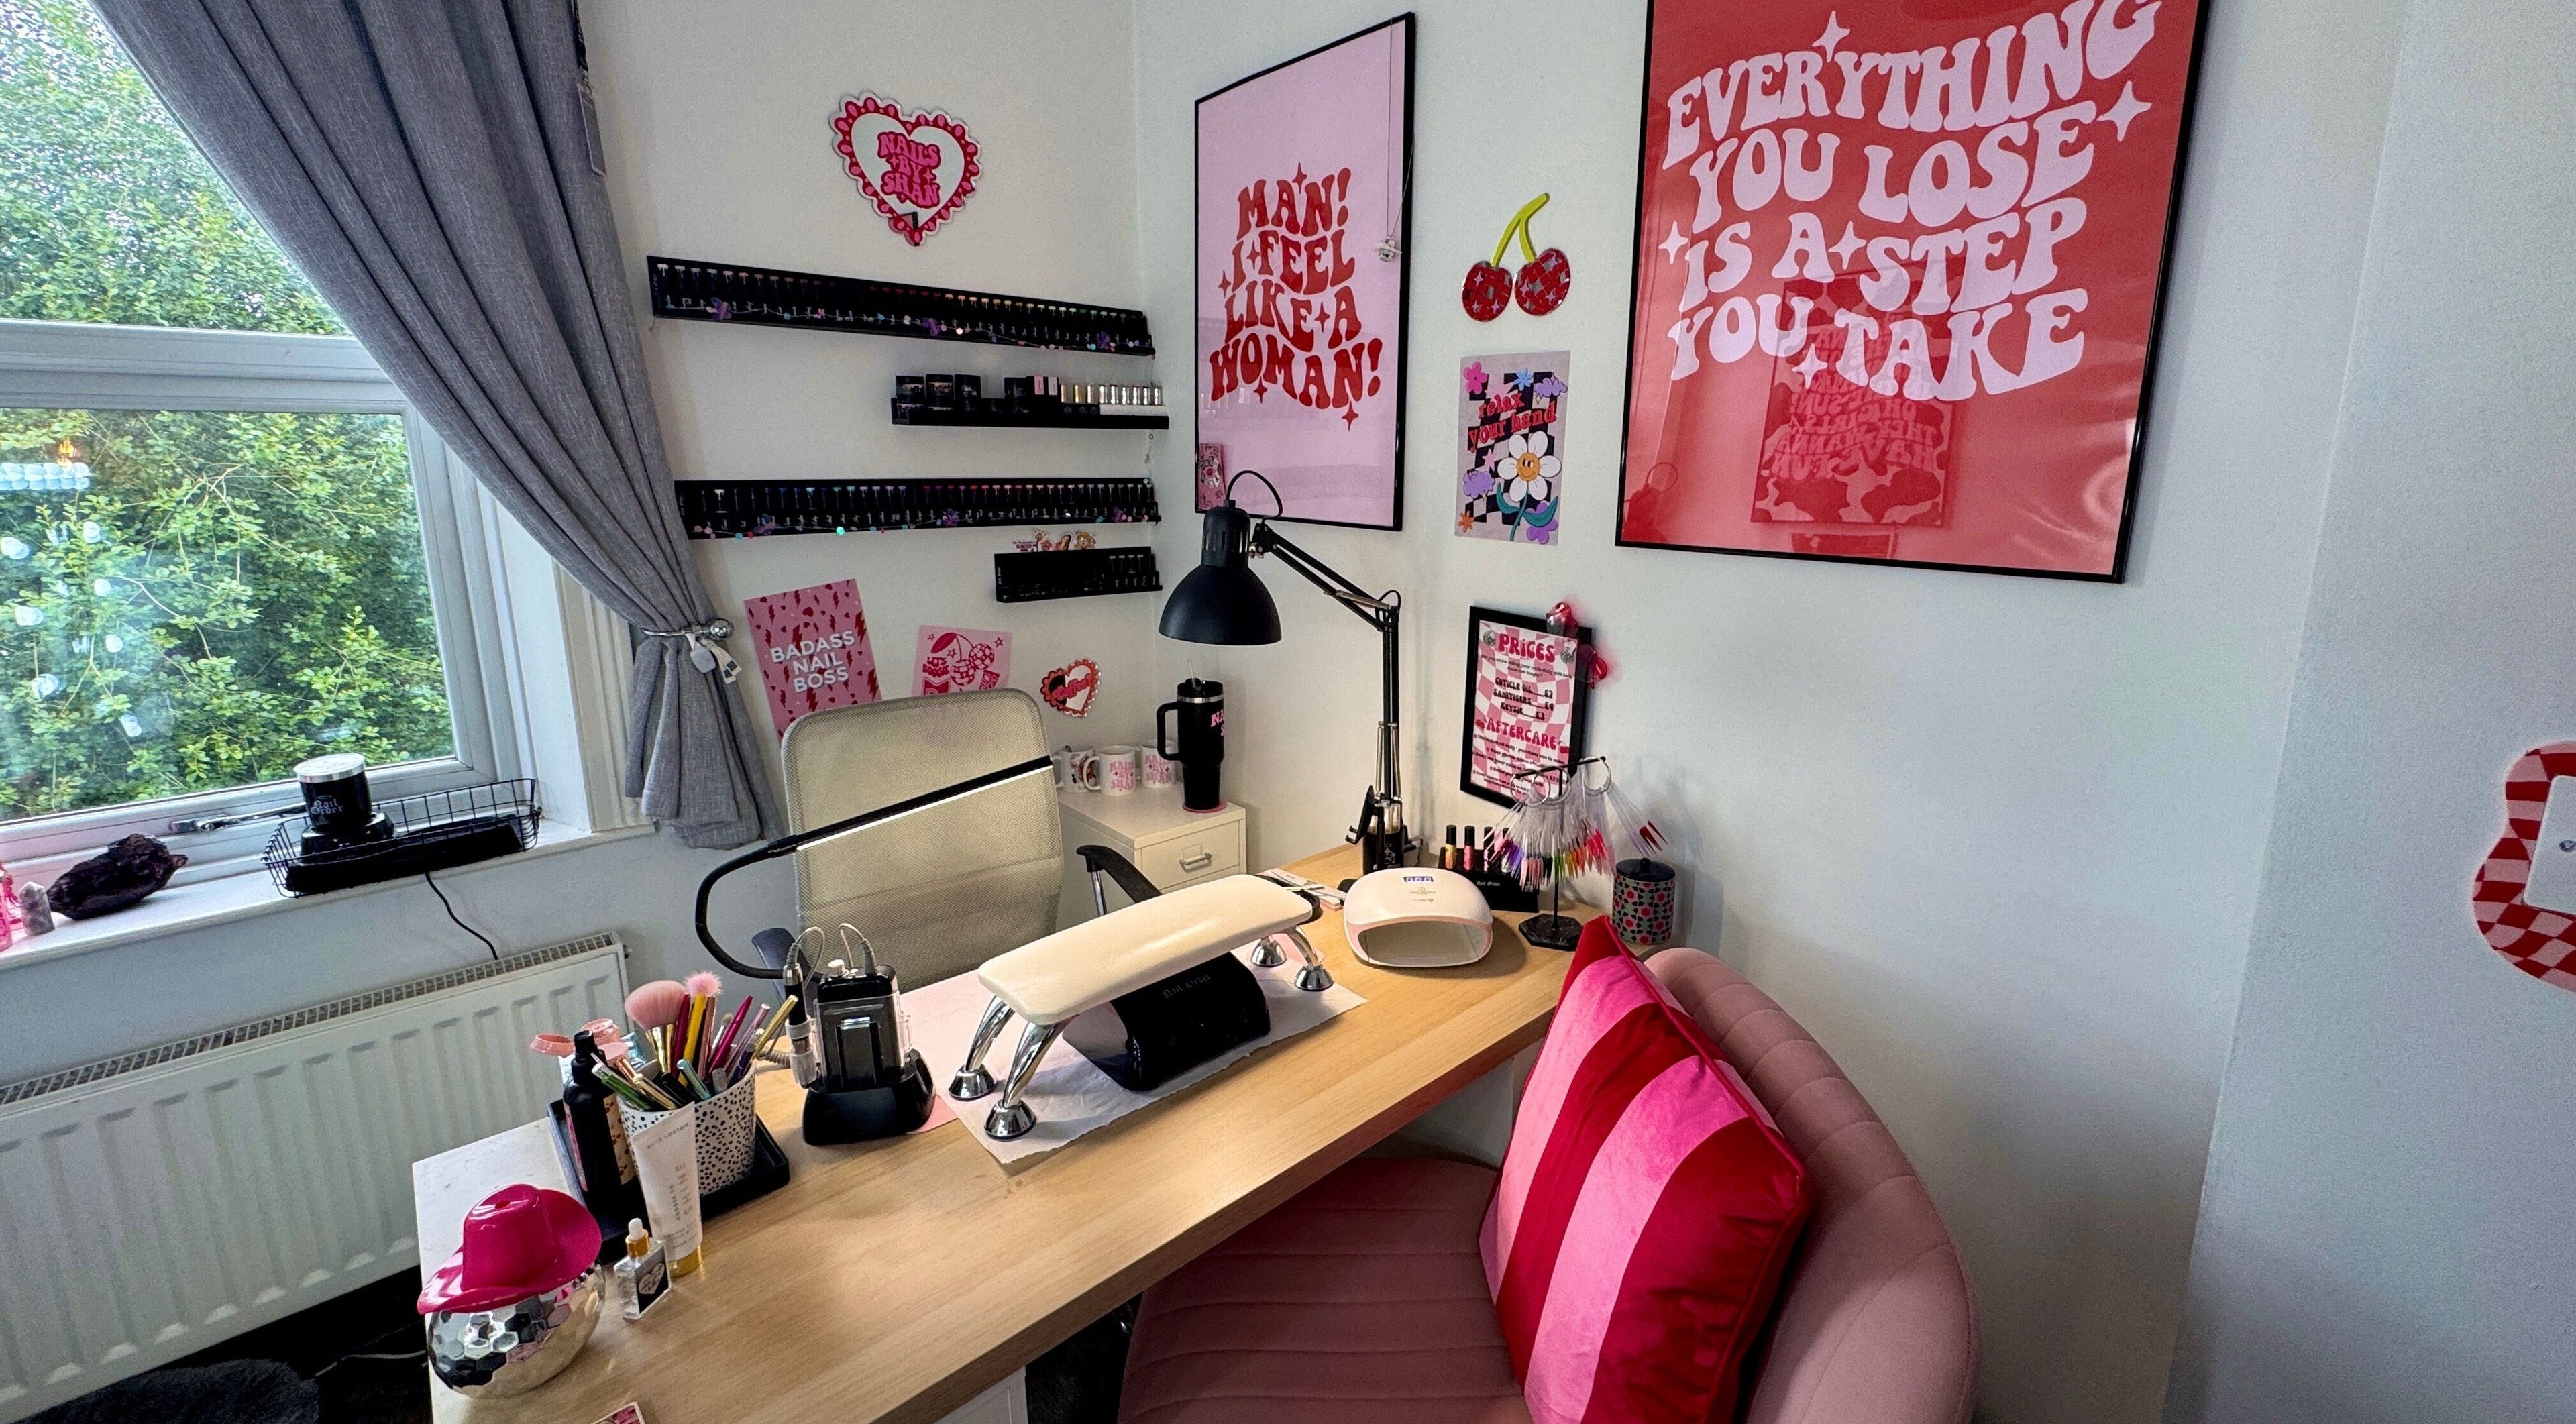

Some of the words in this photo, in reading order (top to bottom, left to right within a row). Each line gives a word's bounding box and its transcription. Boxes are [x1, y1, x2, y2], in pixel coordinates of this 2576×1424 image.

[1662, 0, 2162, 170] EVERYTHING
[879, 134, 940, 166] NAILS
[899, 155, 924, 184] BY
[1689, 128, 1841, 234] YOU
[1858, 101, 2097, 227] LOSE
[883, 172, 939, 206] SHAN
[1237, 168, 1351, 240] MAN!
[1232, 241, 1246, 293] I
[1258, 229, 1355, 295] FEEL
[1679, 221, 1752, 313] IS
[1772, 212, 1835, 284] A
[1858, 198, 2087, 316] STEP
[1225, 279, 1314, 353] LIKE
[1328, 285, 1362, 349] A
[1209, 333, 1383, 410] WOMAN!
[1667, 294, 1814, 381] YOU
[1834, 288, 2088, 402] TAKE
[1468, 419, 1507, 453] your
[1511, 400, 1557, 435] hand
[1478, 392, 1525, 419] relax
[770, 631, 855, 663] BADASS
[792, 656, 843, 676] NAIL
[793, 669, 849, 693] BOSS
[1486, 717, 1557, 751] AFTERCARE
